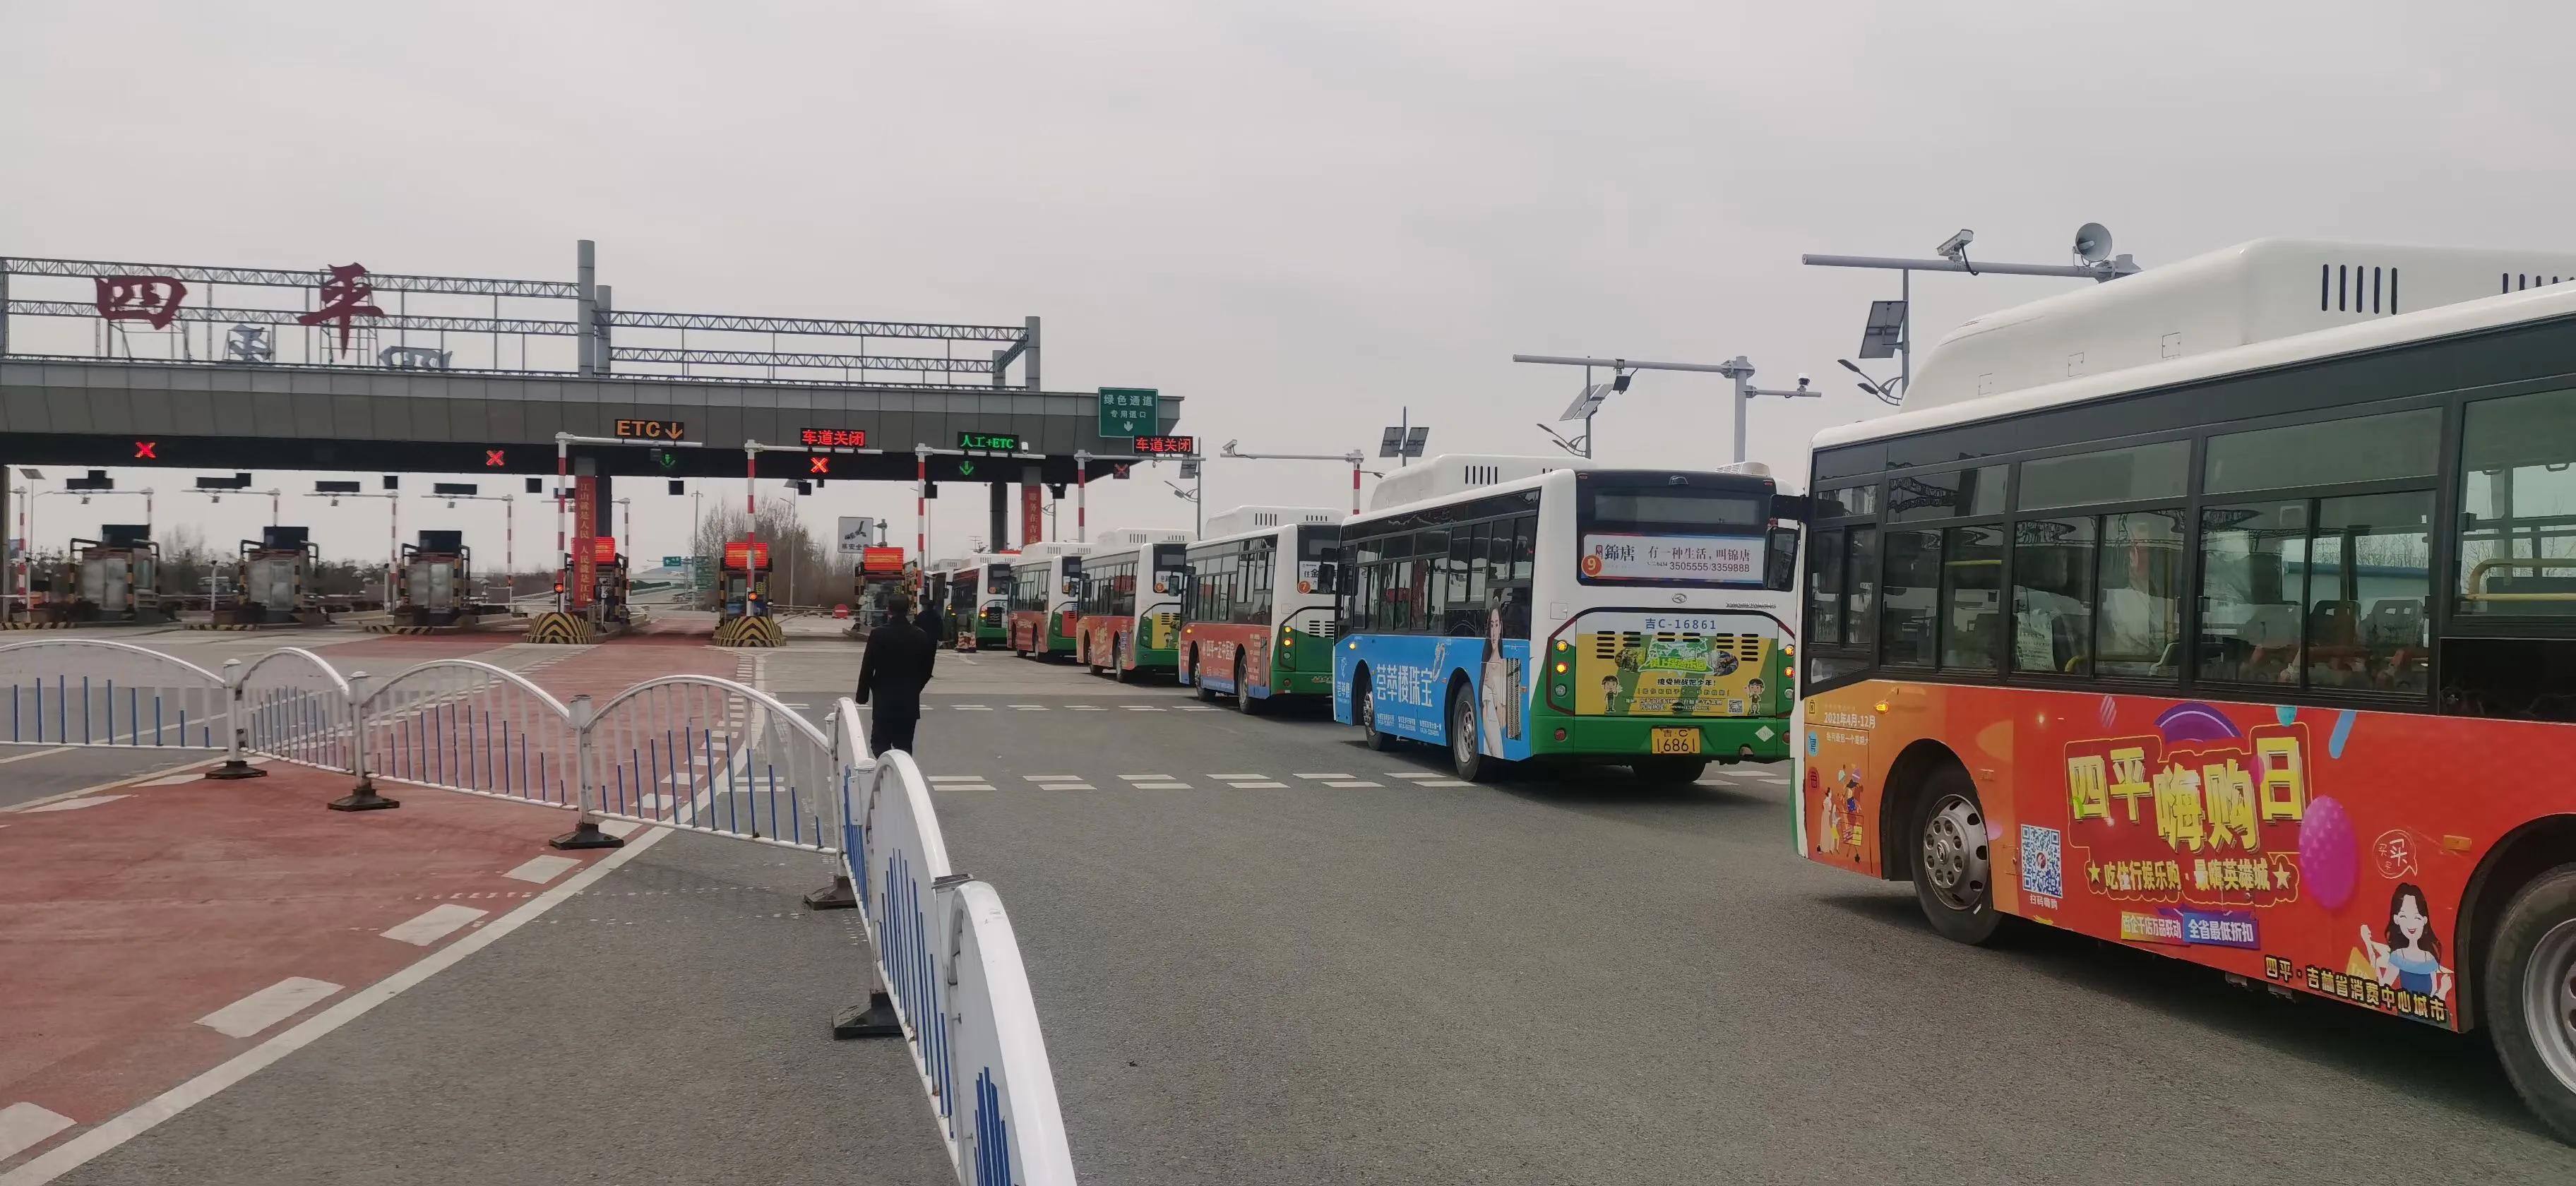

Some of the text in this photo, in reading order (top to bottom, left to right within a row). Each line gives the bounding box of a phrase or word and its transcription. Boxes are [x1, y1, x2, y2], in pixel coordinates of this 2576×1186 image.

[95, 262, 385, 359] 四平
[1104, 395, 1153, 407] 绿色通道
[1111, 409, 1146, 419] 专用道口
[617, 420, 661, 438] ETC
[801, 429, 865, 446] 车道关闭
[960, 434, 1014, 449] 人工+ETC
[1135, 437, 1192, 453] 车道关闭
[1587, 558, 1597, 570] 9
[1669, 562, 1751, 573] 3505555/3359888
[1645, 618, 1717, 630] 吉C-16861
[1377, 663, 1433, 707] 荟萃楼珠宝
[1823, 712, 1876, 729] 2021年4月-12月
[1657, 738, 1695, 752] 16861
[2068, 736, 2306, 853] 四平嗨购日
[2390, 838, 2408, 867] 买
[2029, 894, 2058, 911] 扫码嗨购
[2188, 918, 2254, 942] 全省最低折扣
